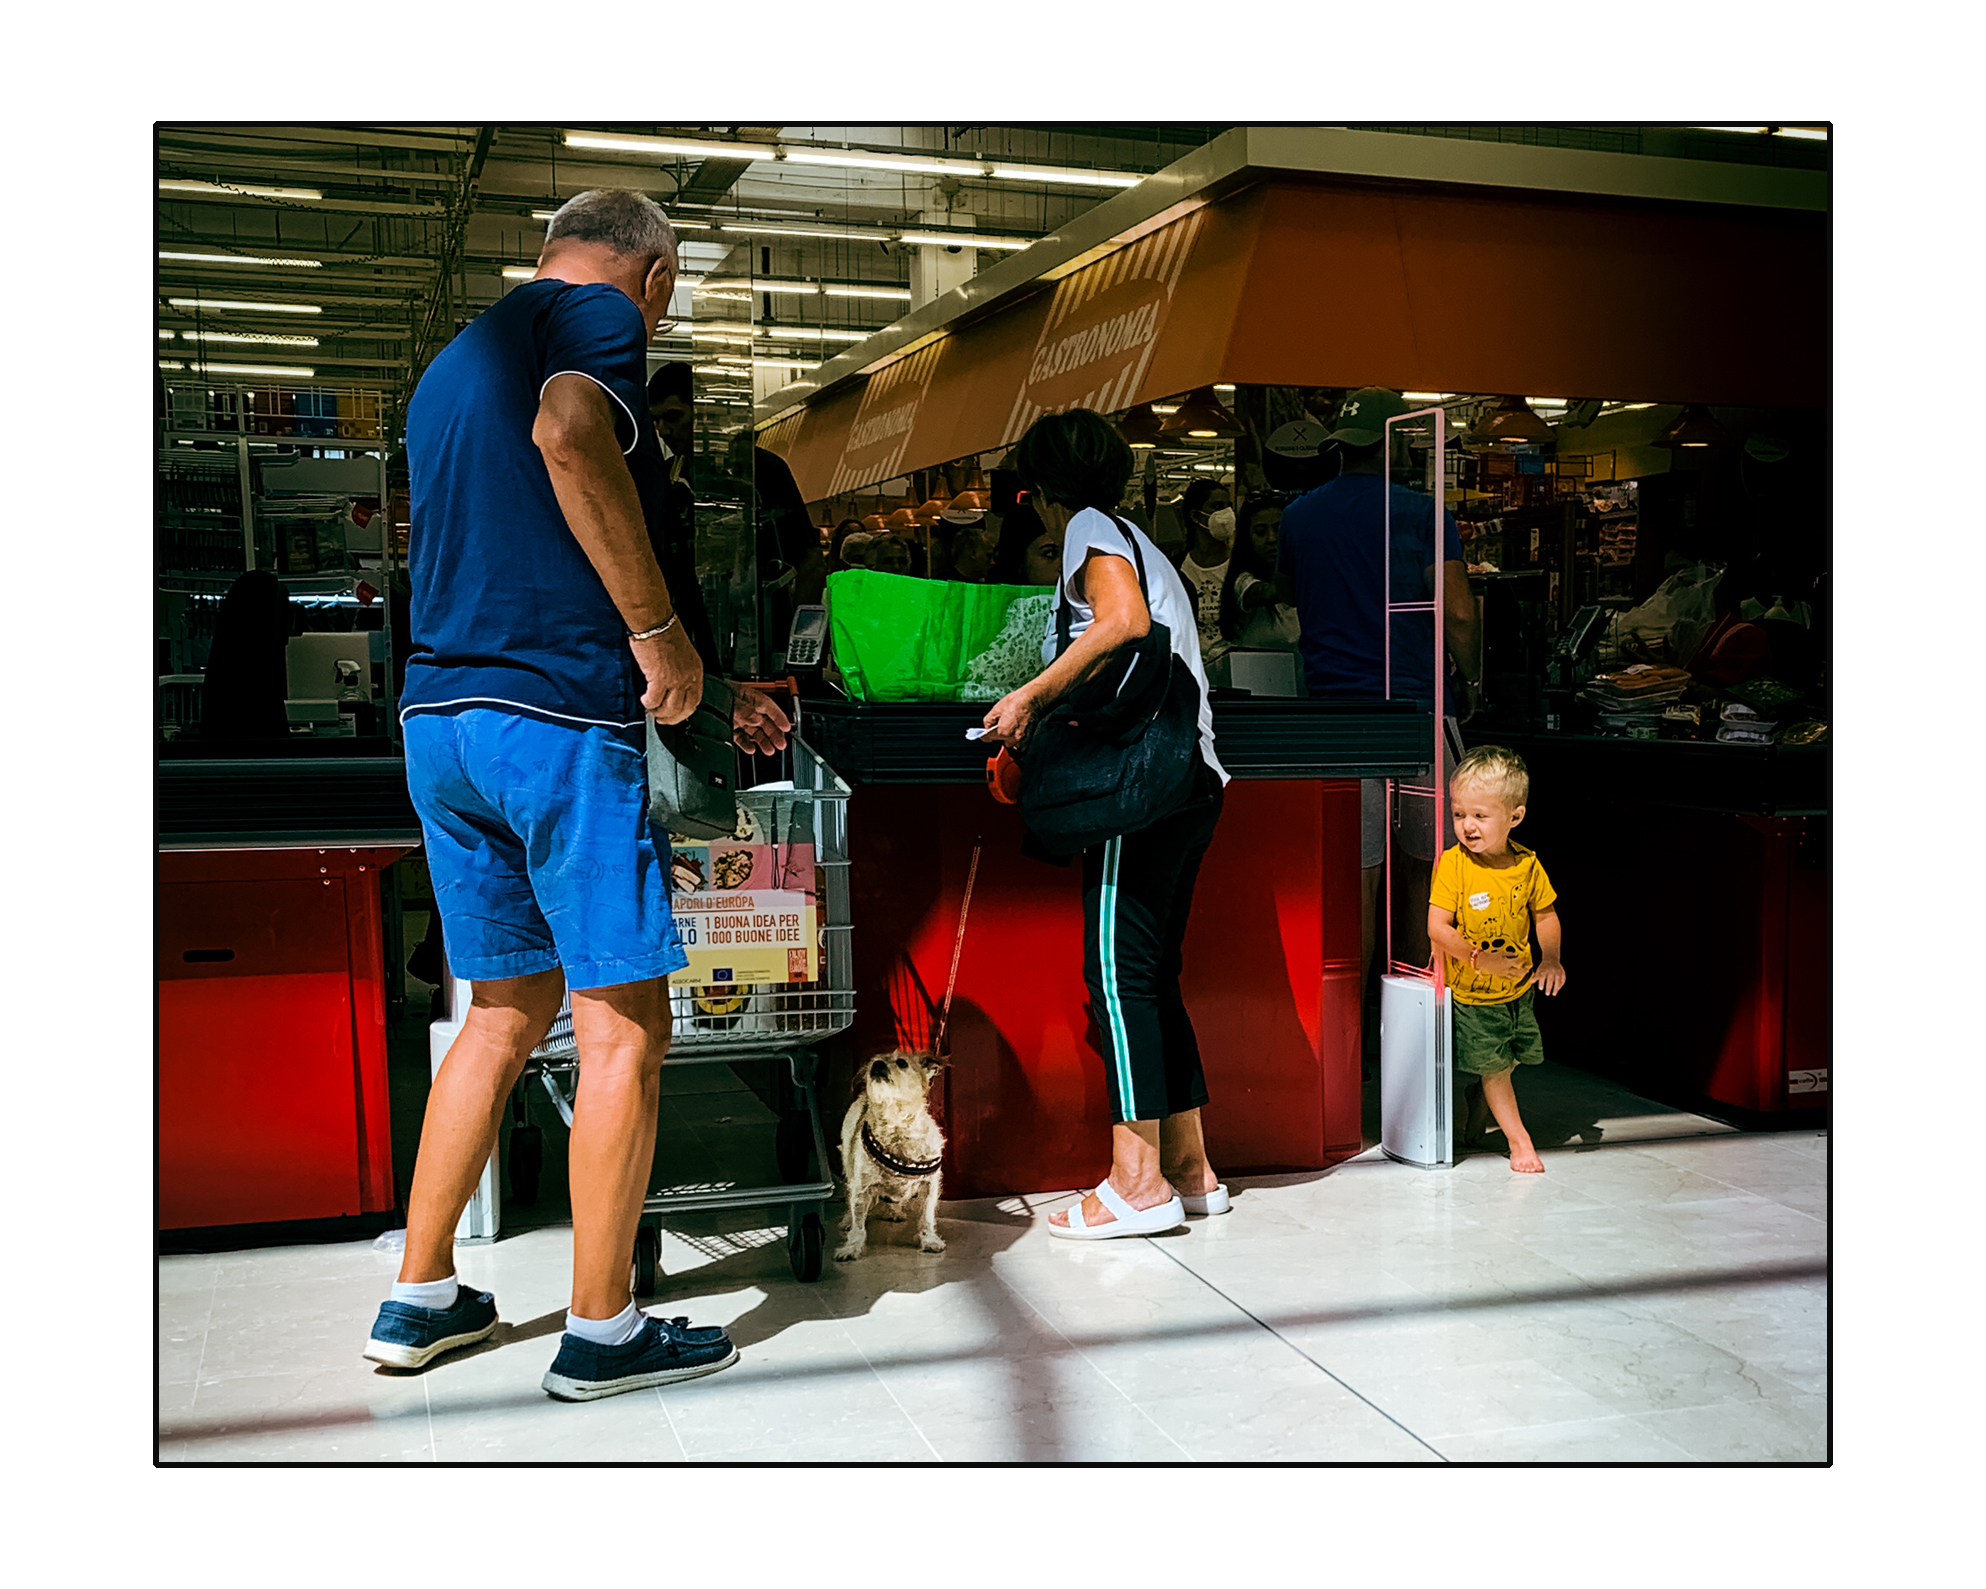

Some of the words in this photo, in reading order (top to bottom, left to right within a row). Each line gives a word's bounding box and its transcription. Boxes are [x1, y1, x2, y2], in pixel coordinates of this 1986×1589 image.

[1028, 298, 1160, 386] GASTRONOMIA
[845, 400, 919, 453] GASTRONOMIA
[673, 898, 704, 910] APORI
[706, 896, 754, 909] D'EUROPA
[705, 916, 711, 929] 1
[714, 915, 750, 929] BUONA
[752, 914, 777, 928] IDEA
[779, 914, 800, 927] PER
[680, 928, 697, 946] LO
[705, 931, 732, 945] 1000
[735, 929, 772, 943] BUONE
[775, 928, 800, 942] IDEE
